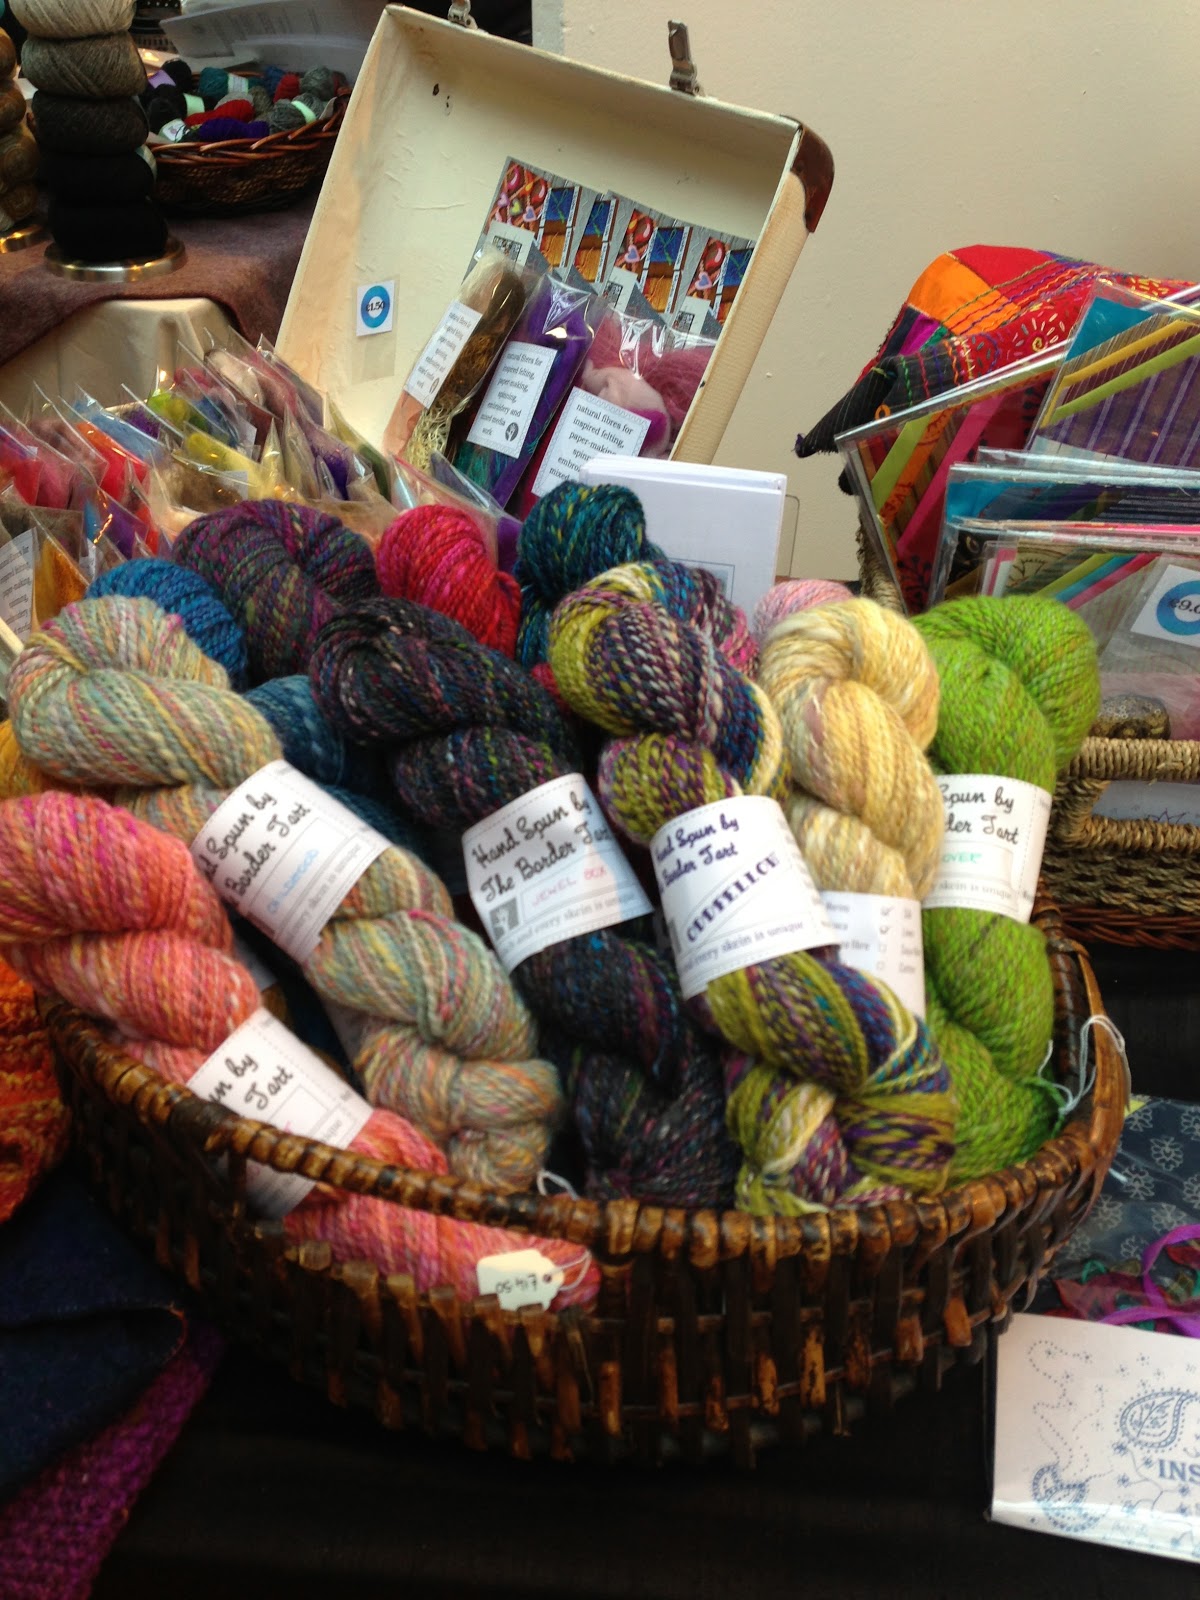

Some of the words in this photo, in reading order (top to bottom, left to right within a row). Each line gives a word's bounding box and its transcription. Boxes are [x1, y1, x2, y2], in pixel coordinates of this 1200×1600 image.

[366, 300, 386, 312] £1.50
[573, 417, 602, 435] inspired
[601, 430, 625, 449] felting,
[576, 404, 602, 420] natural
[601, 414, 621, 429] fibres
[622, 424, 634, 435] for
[549, 467, 570, 481] mixed
[994, 786, 1014, 814] by
[206, 812, 255, 860] Spun
[245, 792, 277, 811] by
[472, 826, 520, 869] Hand
[516, 806, 569, 840] Spun
[570, 790, 592, 815] by
[676, 823, 716, 849] Spun
[720, 812, 740, 832] by
[981, 814, 1019, 845] Tart
[225, 842, 276, 897] Border
[266, 803, 311, 838] Tart
[698, 842, 738, 866] Tart
[480, 874, 516, 902] The
[514, 841, 576, 881] Border
[584, 865, 606, 880] BOX
[224, 1054, 259, 1078] by
[244, 1065, 294, 1111] Tart
